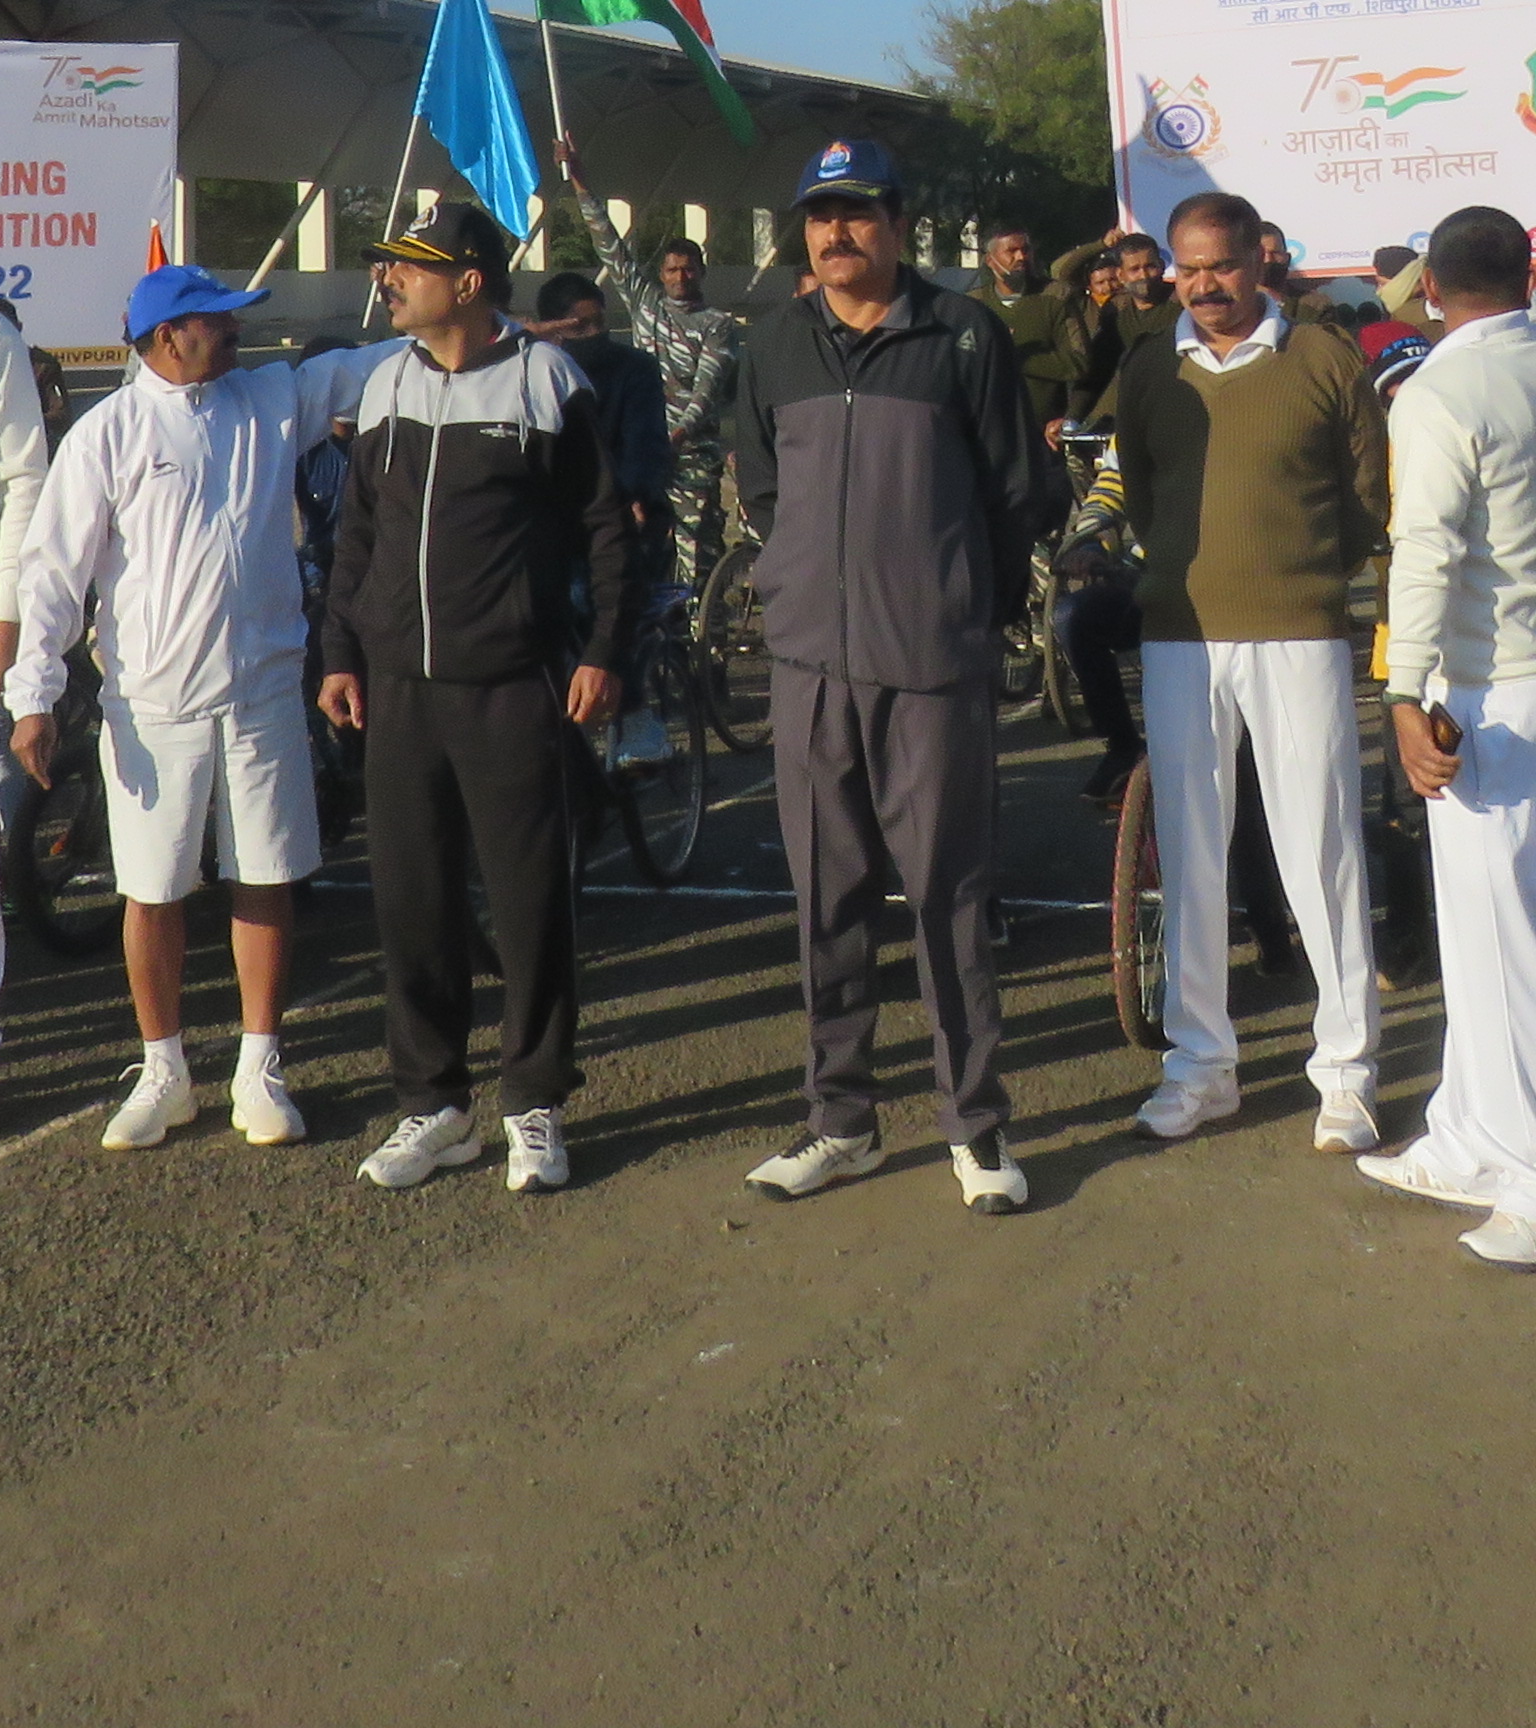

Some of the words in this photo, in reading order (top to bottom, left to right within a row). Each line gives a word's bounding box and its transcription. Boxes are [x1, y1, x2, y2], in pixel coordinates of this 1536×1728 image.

[1275, 7, 1298, 20] आर
[1303, 2, 1319, 18] पी
[39, 92, 93, 108] Azadi
[96, 100, 117, 113] Ka
[33, 111, 77, 123] Amrit
[79, 113, 171, 128] Mahotsav
[1282, 117, 1382, 157] आज़ादी
[1384, 130, 1410, 149] का
[1314, 158, 1383, 194] अमृत
[1390, 145, 1499, 184] महोत्सव
[54, 350, 121, 363] HIVPURI
